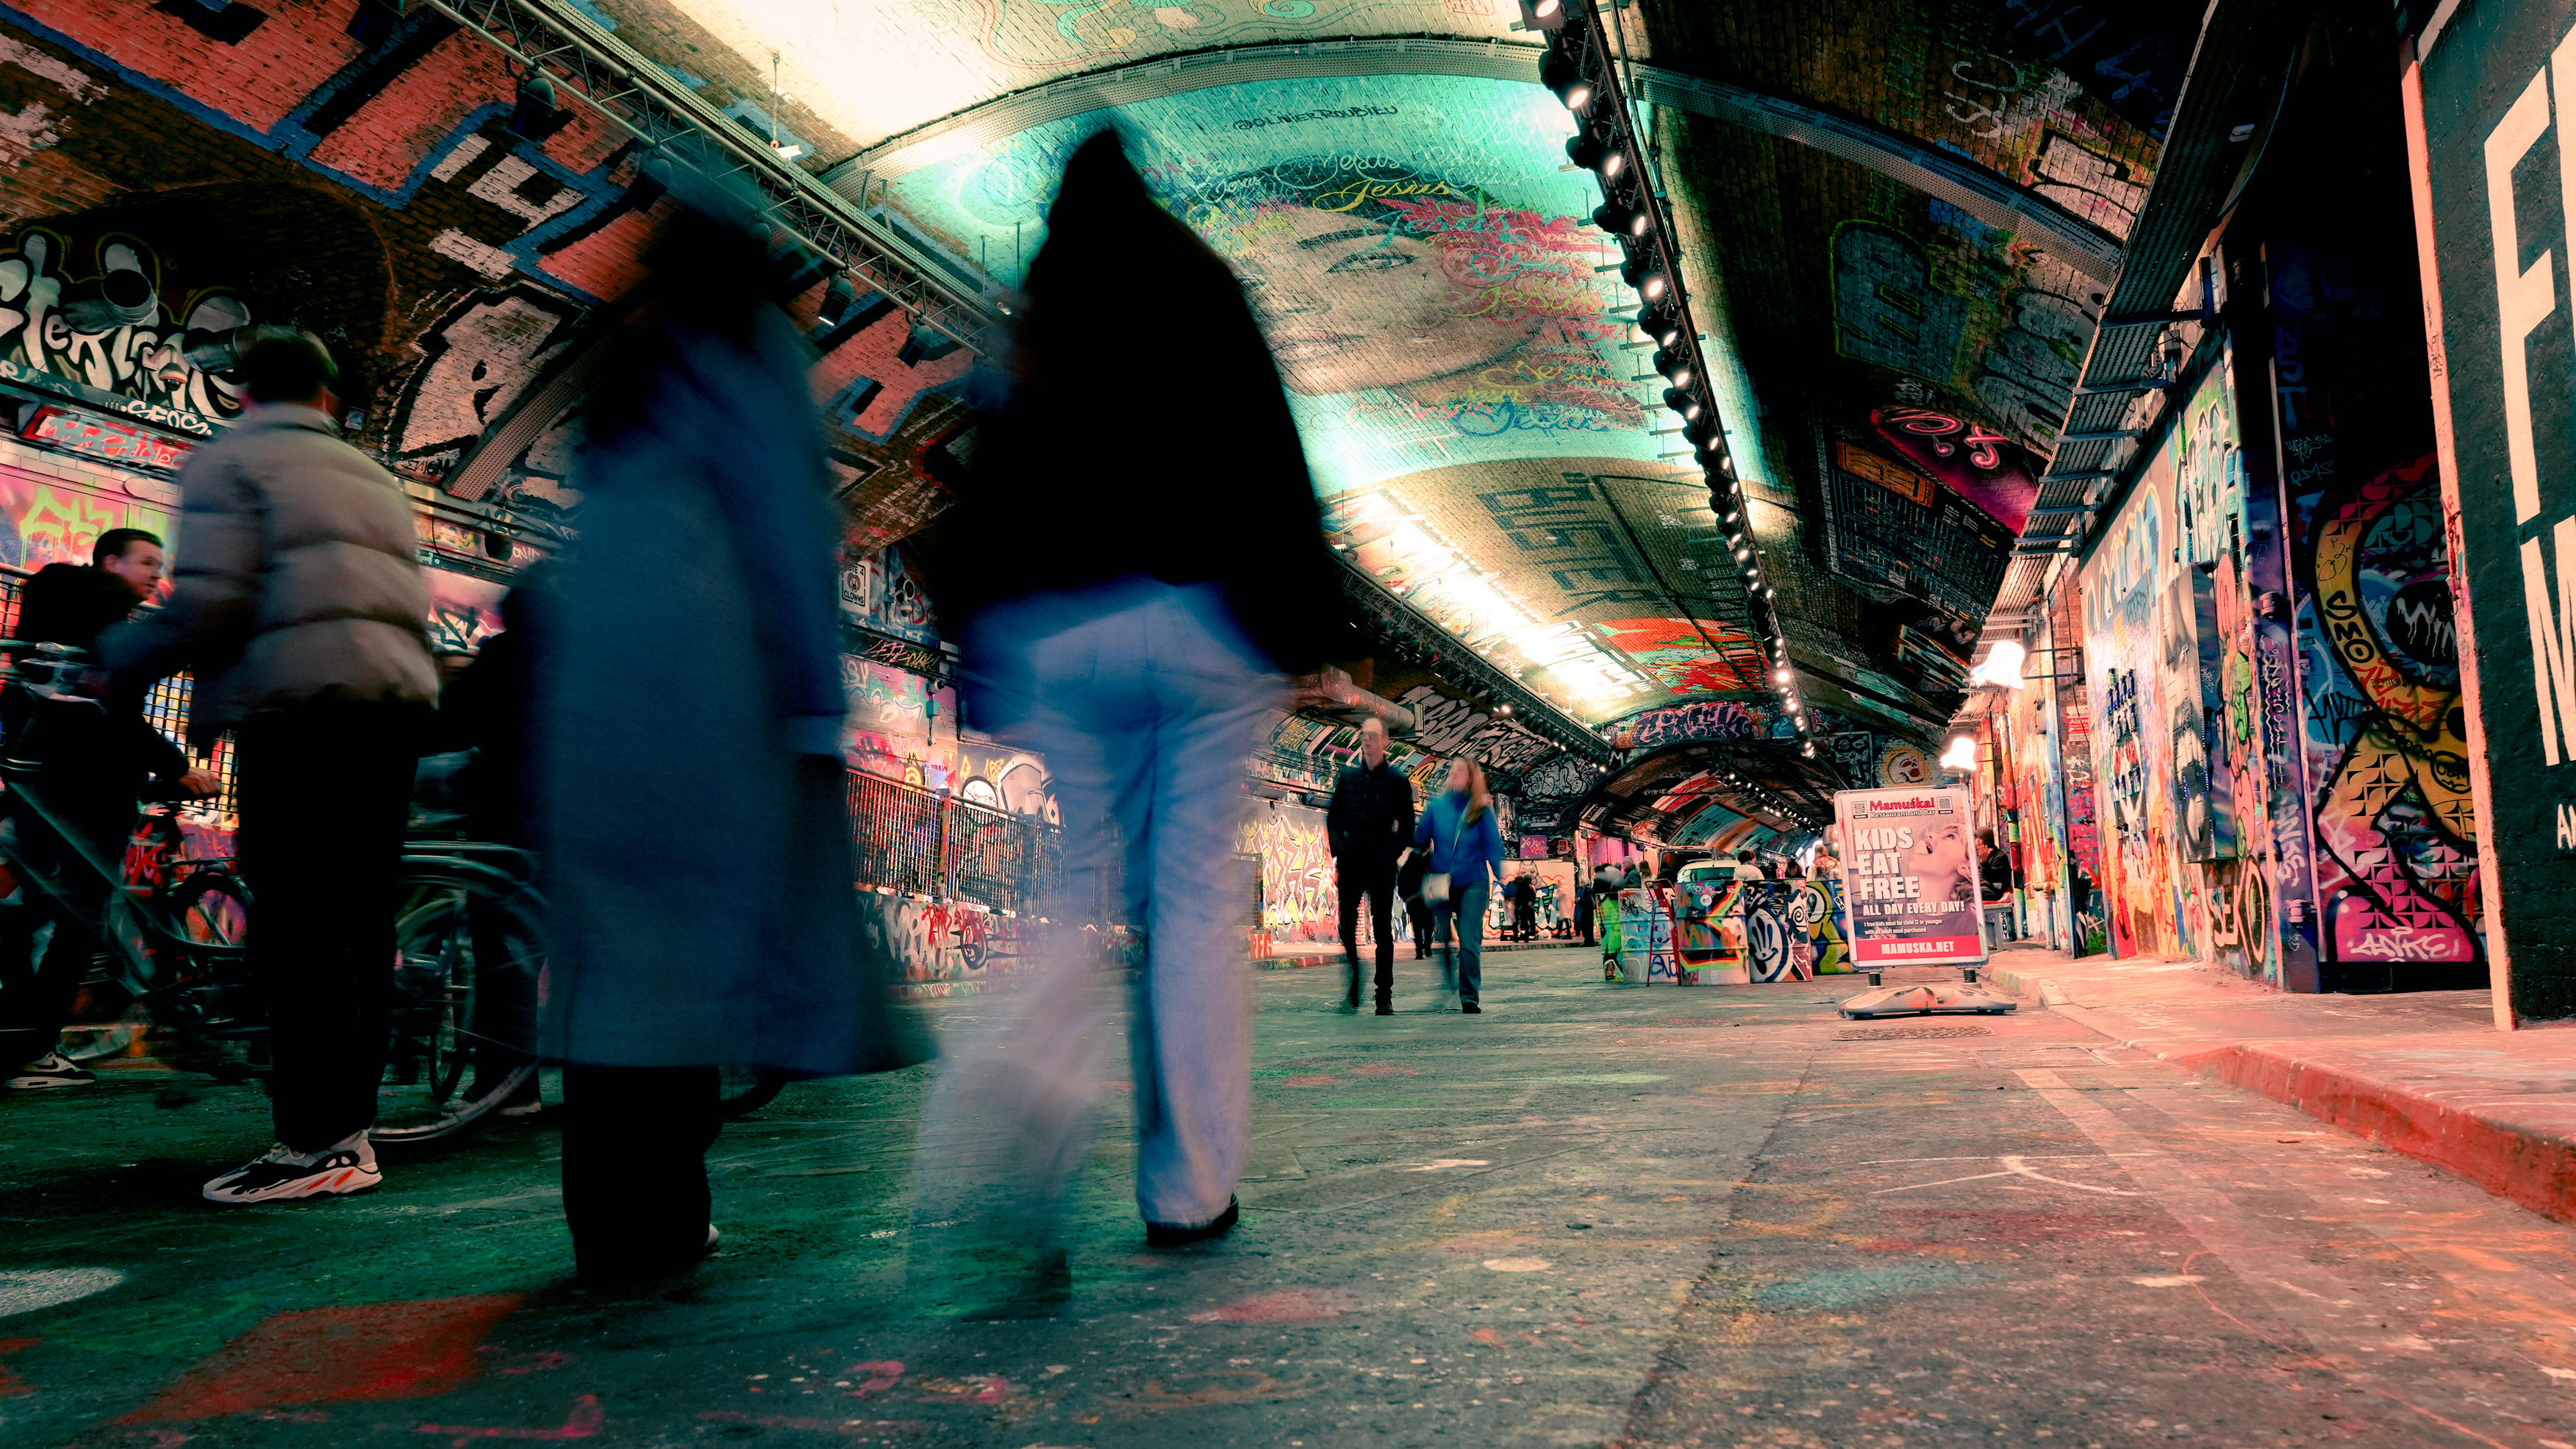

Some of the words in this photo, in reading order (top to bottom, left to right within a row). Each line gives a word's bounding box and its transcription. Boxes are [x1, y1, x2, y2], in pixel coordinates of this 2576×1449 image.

[1313, 179, 1450, 212] Jesus
[860, 568, 864, 576] 4
[843, 590, 864, 604] CLOWNS
[1854, 826, 1914, 851] KIDS
[1857, 852, 1902, 876] EAT
[1859, 876, 1921, 901] FREE
[1863, 904, 1882, 916] ALL
[1884, 903, 1904, 915] DAY
[1907, 901, 1938, 914] EVERY
[1941, 900, 1966, 912] DAY!
[1881, 941, 1954, 955] MAMUSKA.NET
